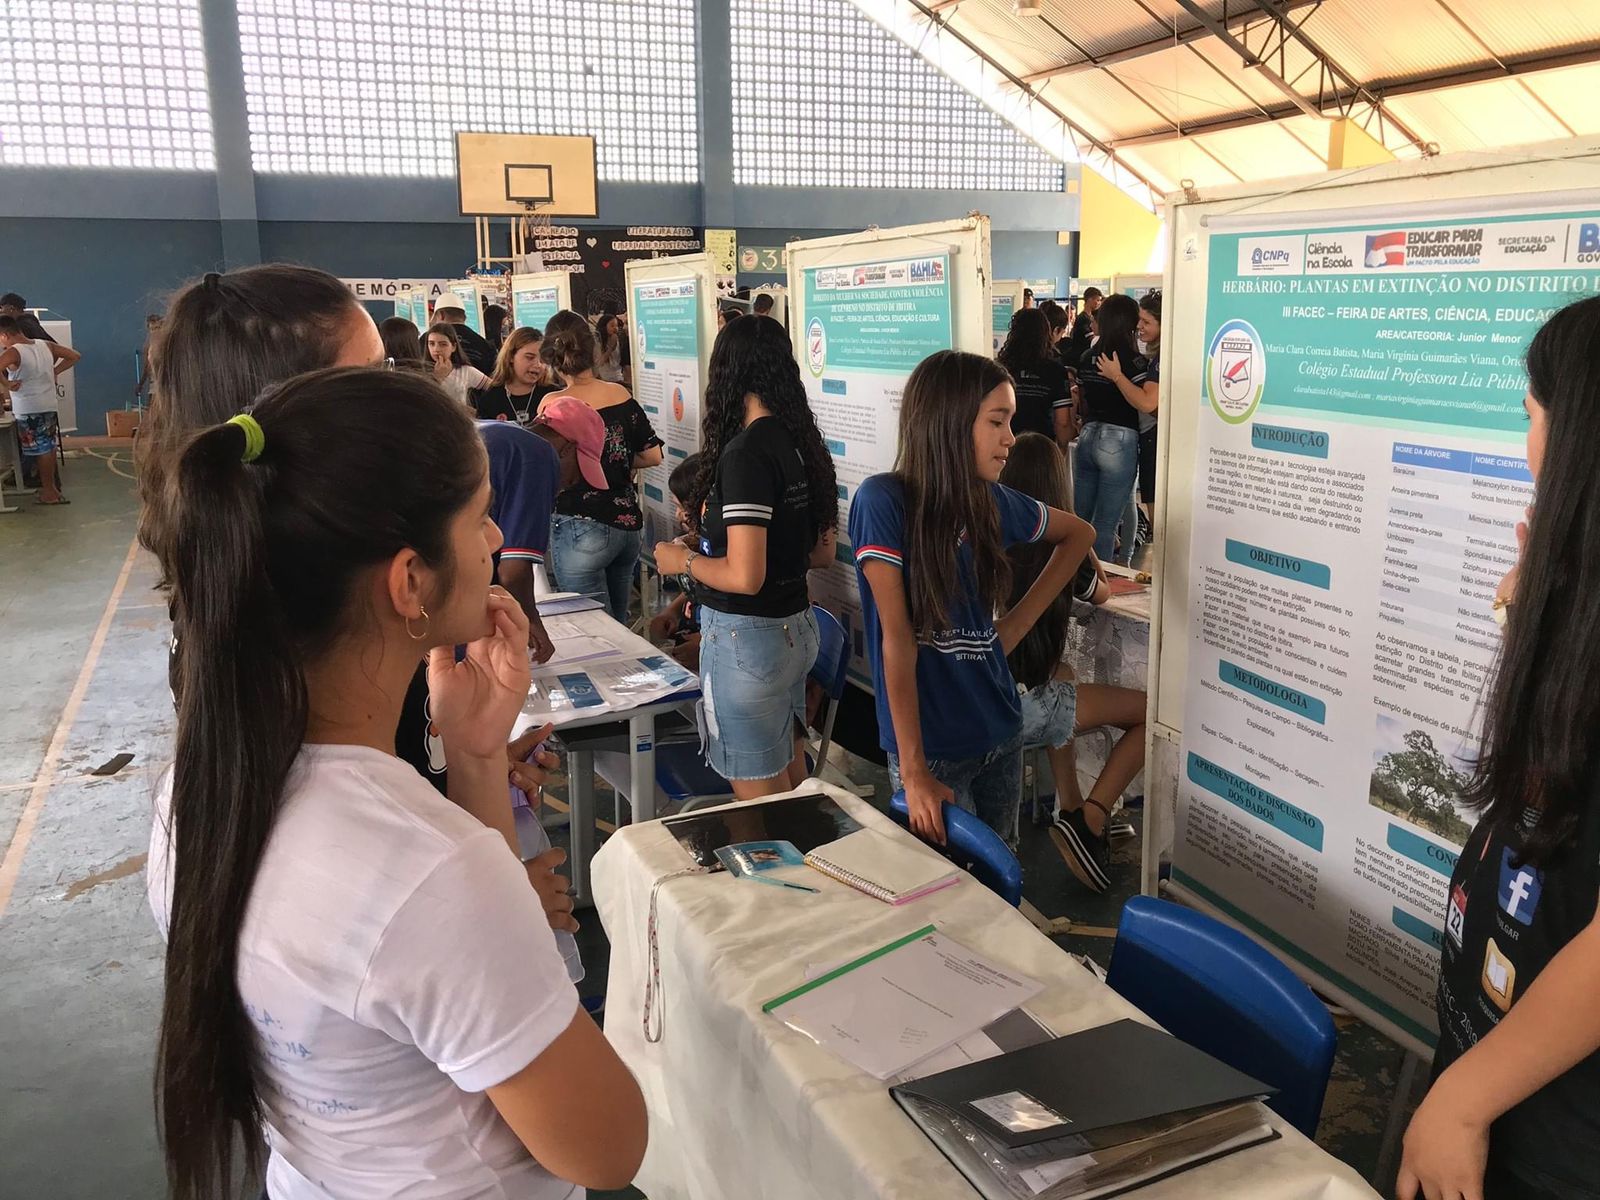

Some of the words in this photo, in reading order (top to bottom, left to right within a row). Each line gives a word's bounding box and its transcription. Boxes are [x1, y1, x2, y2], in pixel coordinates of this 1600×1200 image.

[1407, 231, 1450, 244] EDUCAR
[1452, 229, 1484, 243] PARA
[1498, 236, 1543, 246] SECRETARIA
[1545, 235, 1555, 244] DA
[762, 249, 777, 270] 3
[1263, 250, 1290, 263] CNPq
[1308, 242, 1343, 255] Ciência
[1406, 243, 1482, 258] TRANSFORMAR
[1504, 244, 1548, 254] EDUCAÇÃO
[1307, 259, 1320, 269] na
[1322, 257, 1353, 269] Escola
[1449, 257, 1480, 265] EDUCAÇÃO
[1222, 277, 1287, 294] HERBÁRIO:
[1290, 279, 1349, 294] PLANTAS
[1352, 279, 1376, 293] EM
[1379, 274, 1461, 296] EXTINÇÃO
[1465, 277, 1491, 293] NO
[1495, 275, 1587, 293] DISTRITO
[1292, 306, 1326, 317] FACEC
[1336, 307, 1368, 318] FEIRA
[1370, 307, 1385, 319] DE
[1388, 307, 1431, 323] ARTES,
[1435, 305, 1491, 323] CIÊNCIA,
[1375, 330, 1454, 341] AREA/CATEGORIA:
[1457, 332, 1487, 343] Junior
[1491, 333, 1523, 344] Menor
[1265, 344, 1284, 354] Maria
[1286, 344, 1304, 354] Clara
[1306, 346, 1332, 356] Correia
[1333, 347, 1360, 358] Batista,
[1361, 349, 1384, 359] Maria
[1387, 350, 1419, 364] Virgínia
[1421, 352, 1468, 364] Guimarães
[1471, 353, 1499, 366] Viana,
[1299, 361, 1338, 379] Colégio
[1340, 363, 1388, 381] Estadual
[1391, 367, 1457, 387] Professora
[1460, 371, 1482, 388] Lia
[1252, 426, 1325, 448] INTRODUÇÃO
[1395, 445, 1413, 454] NOME
[1414, 447, 1423, 455] DA
[1423, 447, 1451, 459] ÁRVORE
[1474, 456, 1495, 466] NOME
[1287, 460, 1317, 473] tecnologia
[1336, 469, 1365, 482] avançada
[1295, 472, 1324, 485] ampliados
[1331, 478, 1364, 492] associados
[1290, 481, 1308, 492] dando
[1336, 490, 1363, 502] resultado
[1277, 499, 1291, 508] cada
[1303, 505, 1316, 514] vem
[1317, 507, 1352, 522] degradando
[1322, 498, 1352, 511] destruindo
[1299, 514, 1327, 527] acabando
[1334, 522, 1360, 534] entrando
[1469, 514, 1492, 525] Mimosa
[1466, 536, 1497, 549] Terminalia
[1249, 549, 1301, 573] OBJETIVO
[1463, 550, 1492, 562] Spondias
[1461, 575, 1474, 585] Não
[1459, 587, 1473, 597] Não
[1291, 592, 1311, 605] plantas
[1314, 599, 1341, 615] presentes
[1277, 607, 1298, 620] plantas
[1300, 614, 1325, 629] possíveis
[1287, 631, 1311, 646] exemplo
[1313, 640, 1326, 651] para
[1329, 645, 1349, 658] futuros
[1376, 632, 1386, 641] Ao
[1387, 635, 1428, 654] observamos
[1374, 653, 1404, 668] acarretar
[1407, 663, 1436, 679] grandes
[1375, 642, 1403, 658] extinção
[1406, 653, 1415, 661] no
[1419, 656, 1444, 670] Distrito
[1447, 665, 1457, 674] de
[1233, 668, 1308, 710] METODOLOGIA
[1373, 663, 1418, 684] determinadas
[1423, 679, 1454, 697] espécies
[1459, 692, 1470, 702] de
[1373, 696, 1402, 713] Exemplo
[1402, 707, 1412, 717] de
[1413, 711, 1439, 727] espécie
[1440, 721, 1450, 731] de
[1271, 710, 1290, 726] Campo
[1296, 720, 1328, 742] Bibliográfica
[1294, 768, 1319, 788] Secagem
[1194, 758, 1257, 797] APRESENTAÇÃO
[1258, 791, 1264, 801] E
[1266, 794, 1316, 829] DISCUSSÃO
[1227, 789, 1244, 804] DOS
[1245, 798, 1275, 821] DADOS
[1366, 842, 1393, 862] decorrer
[1394, 856, 1404, 867] do
[1405, 862, 1429, 881] projeto
[1367, 862, 1408, 890] demonstrado
[1397, 868, 1444, 898] conhecimento
[1362, 871, 1376, 883] tudo
[1397, 889, 1432, 914] possibilitar
[1451, 906, 1461, 935] 22
